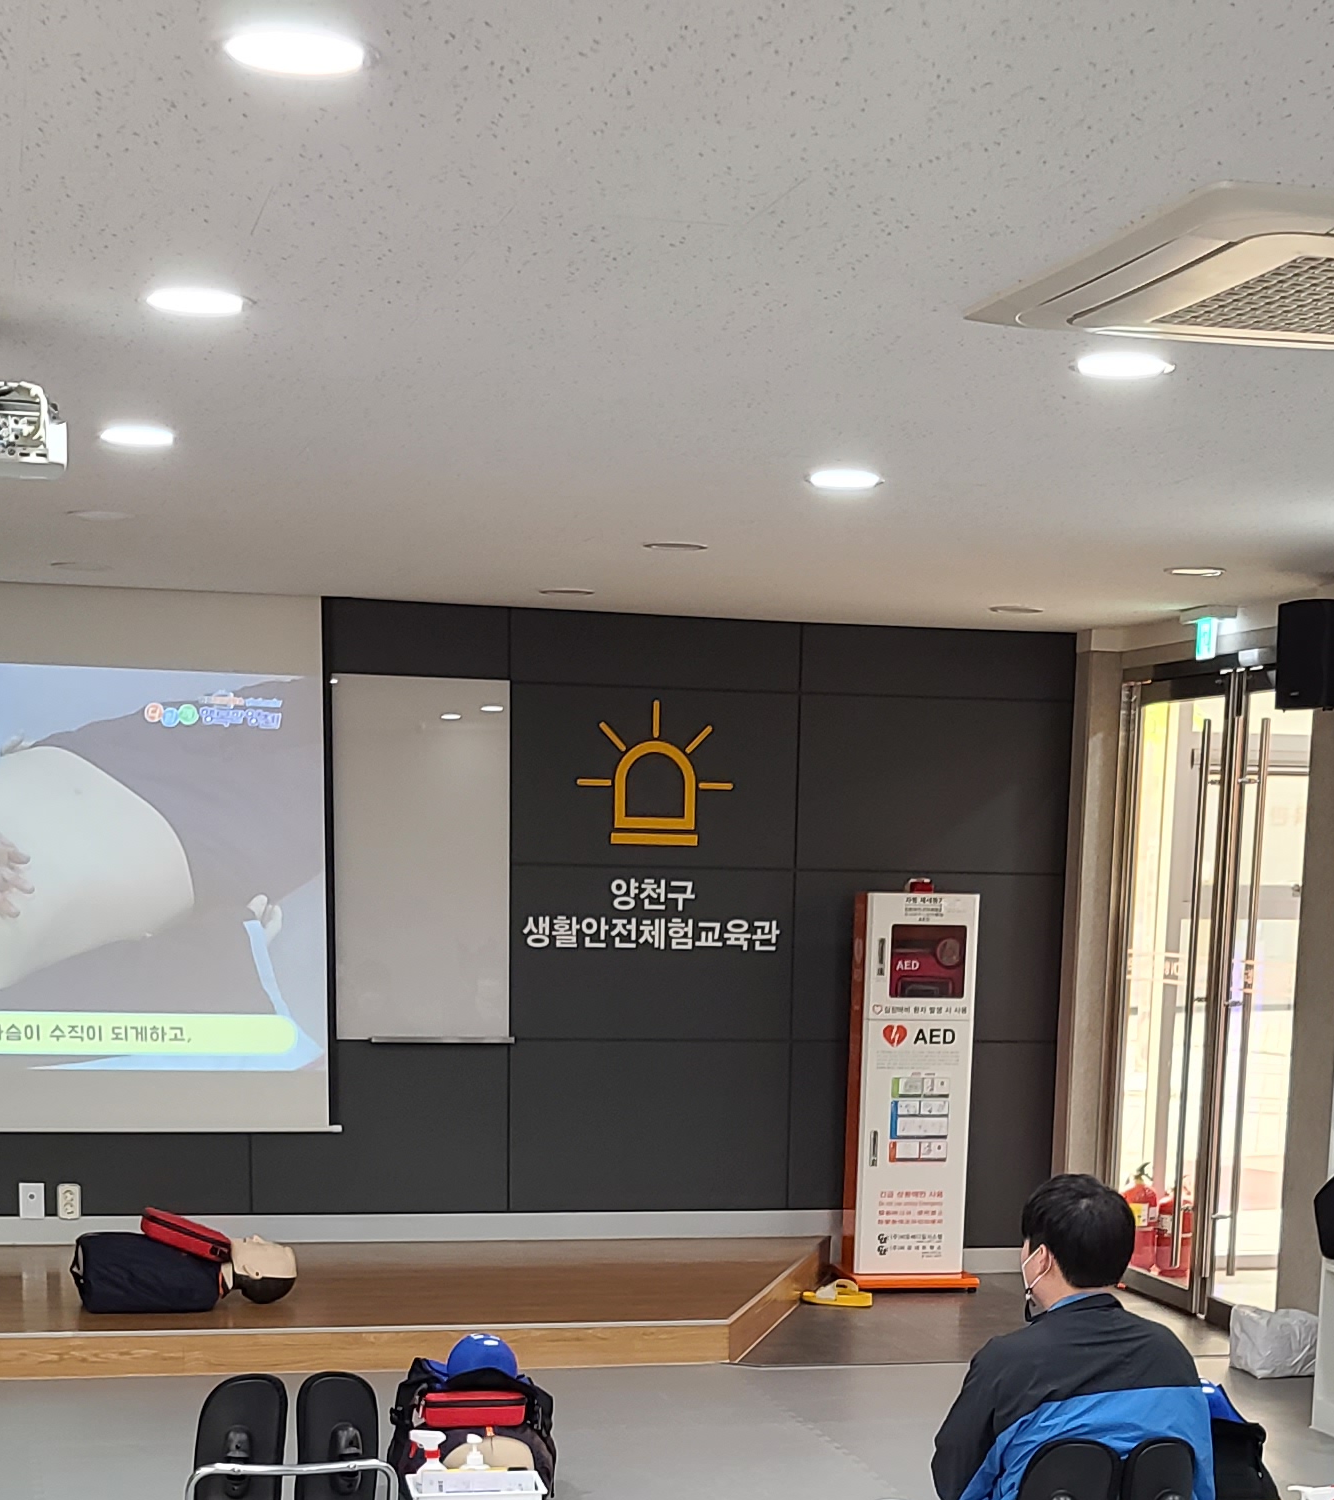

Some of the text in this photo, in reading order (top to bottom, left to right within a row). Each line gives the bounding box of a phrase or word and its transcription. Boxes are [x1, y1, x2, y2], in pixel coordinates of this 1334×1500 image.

[610, 878, 696, 911] 양천구
[522, 915, 781, 951] 생활안전체험교육관
[896, 960, 919, 971] AED
[49, 1024, 103, 1042] 수직이
[110, 1025, 193, 1044] 되게하고,
[913, 1028, 956, 1045] AED
